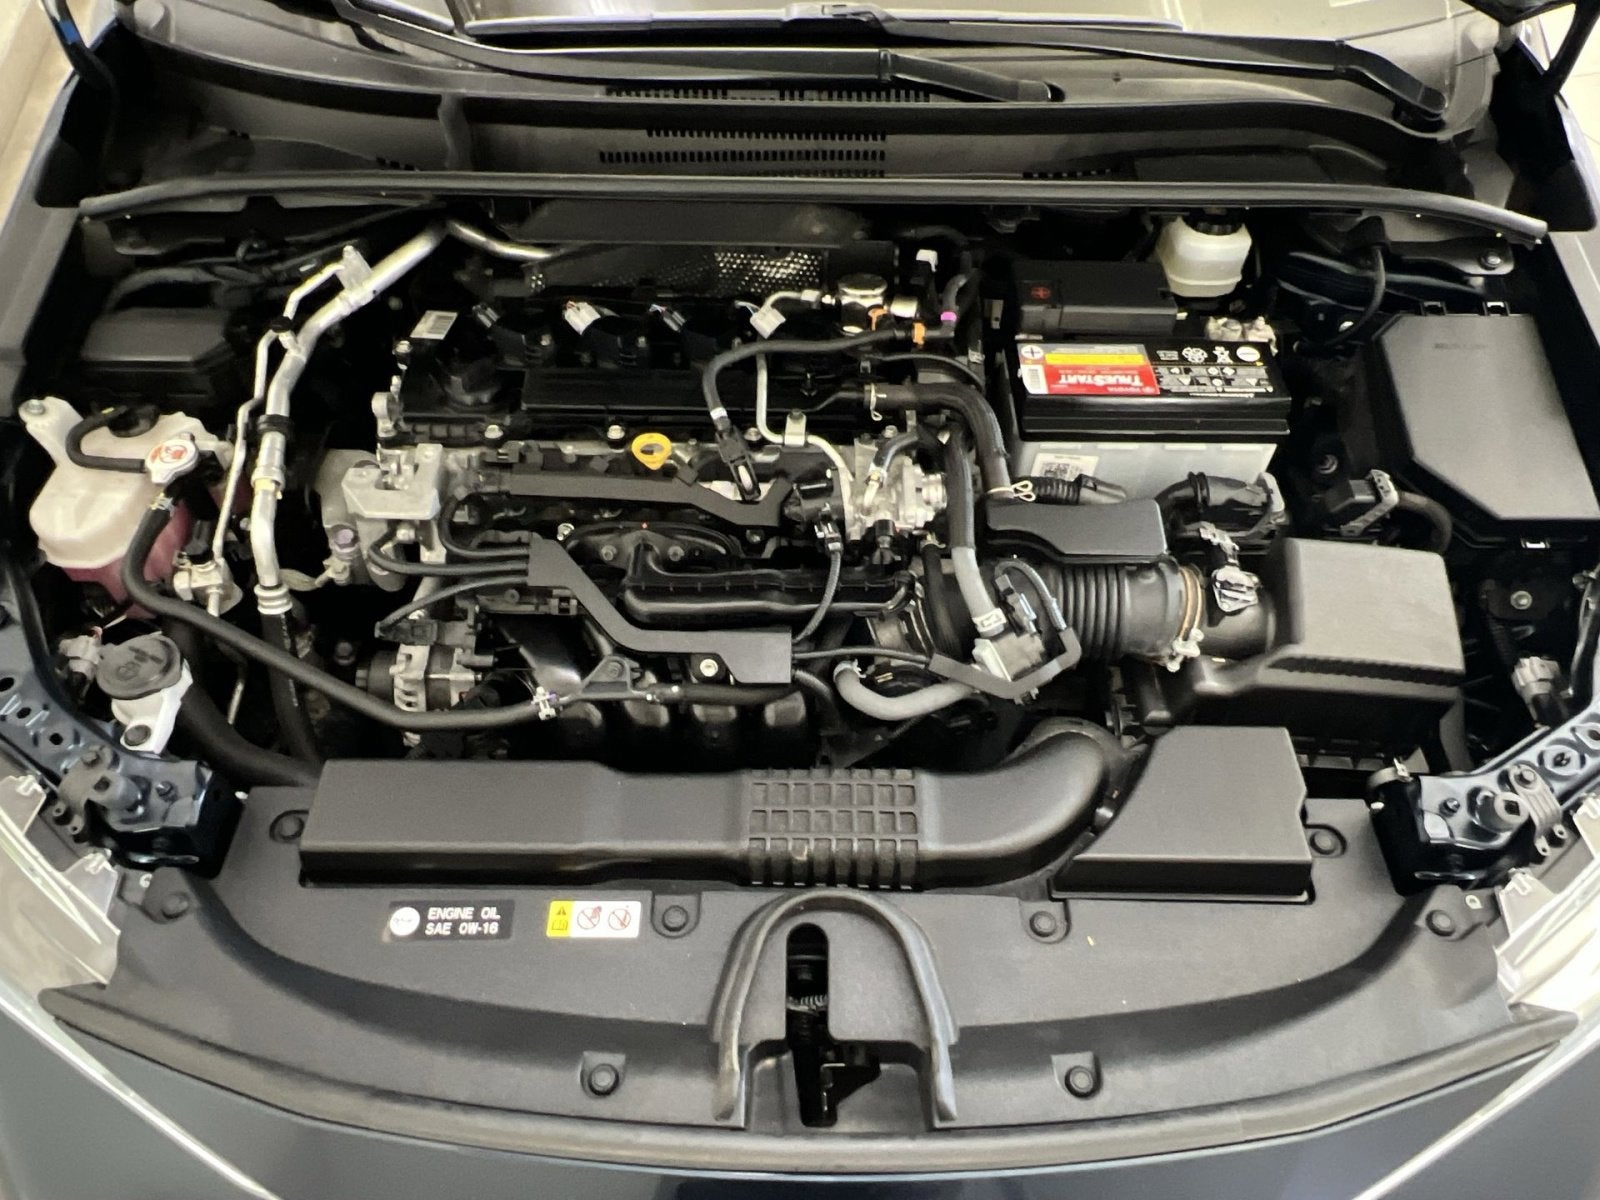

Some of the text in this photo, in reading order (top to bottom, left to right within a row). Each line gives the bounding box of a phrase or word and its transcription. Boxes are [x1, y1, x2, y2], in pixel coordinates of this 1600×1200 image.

[427, 906, 501, 920] ENGINE OIL
[424, 922, 499, 935] SAE 0W-16
